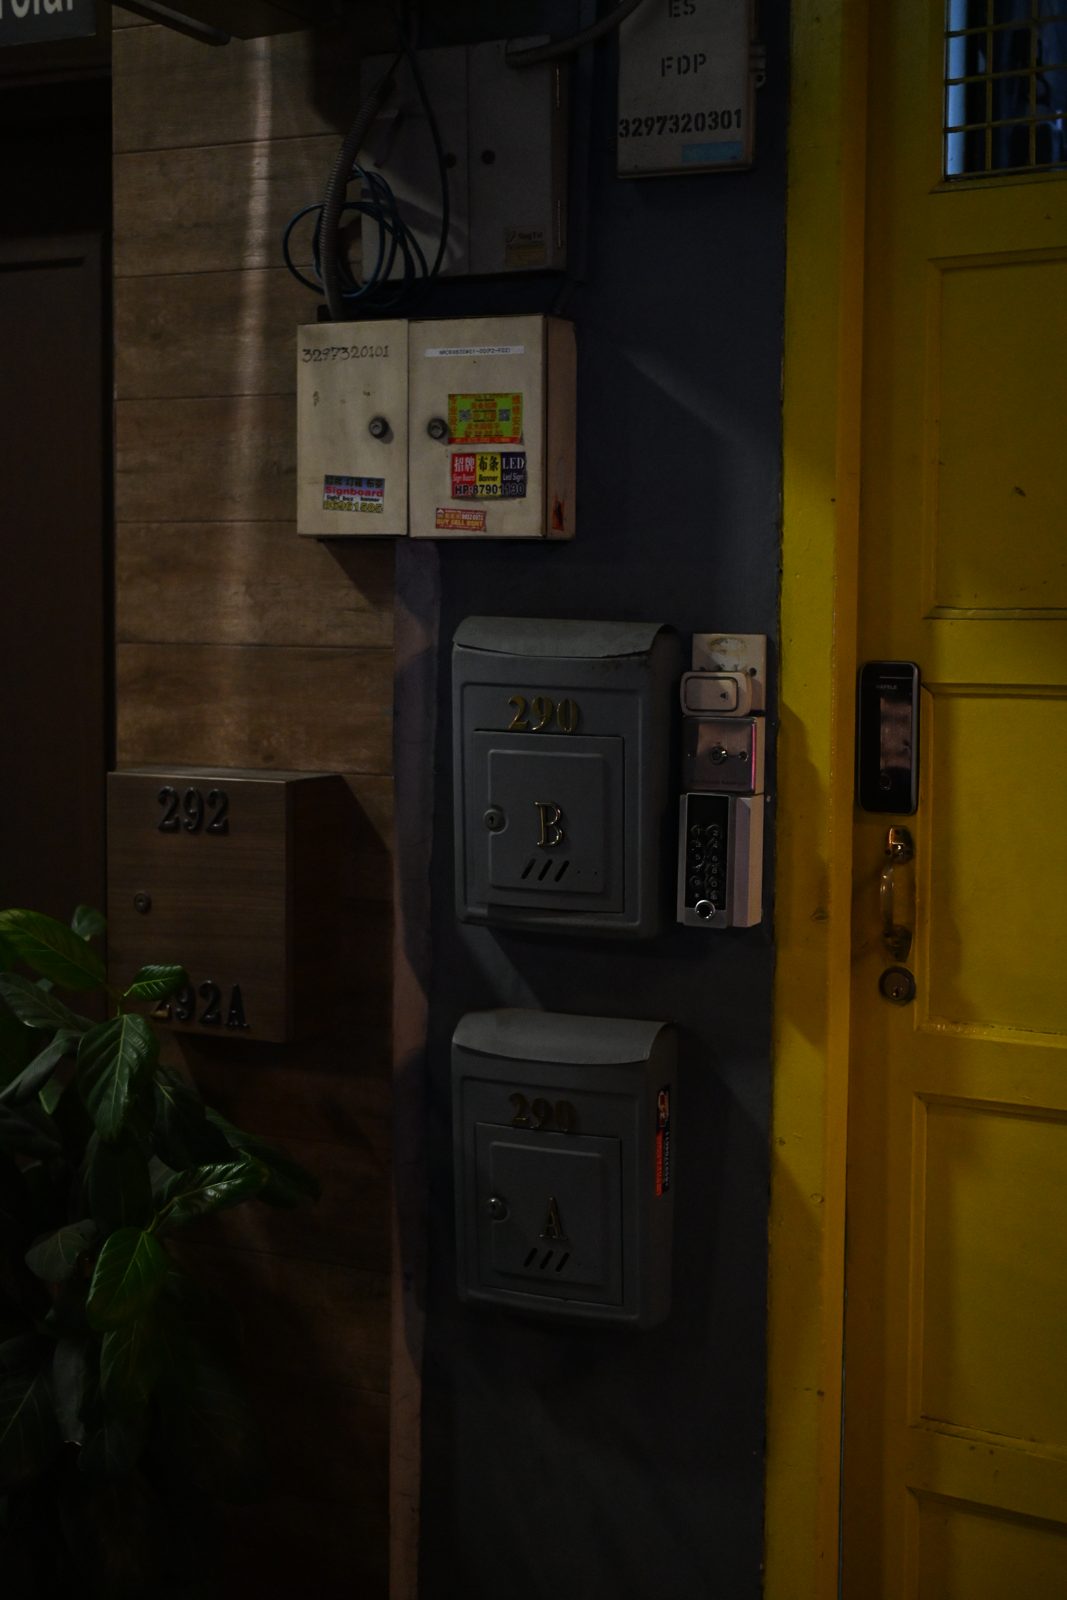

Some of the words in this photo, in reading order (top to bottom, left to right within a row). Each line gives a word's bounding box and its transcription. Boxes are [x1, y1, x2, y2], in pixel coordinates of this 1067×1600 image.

[661, 53, 707, 77] FDP
[618, 108, 742, 138] 3297320301
[502, 457, 525, 470] LED
[326, 486, 384, 497] Signboard
[506, 694, 578, 734] 290
[157, 785, 230, 834] 292
[532, 800, 563, 849] B
[509, 1092, 578, 1134] 290
[536, 1192, 570, 1241] A
